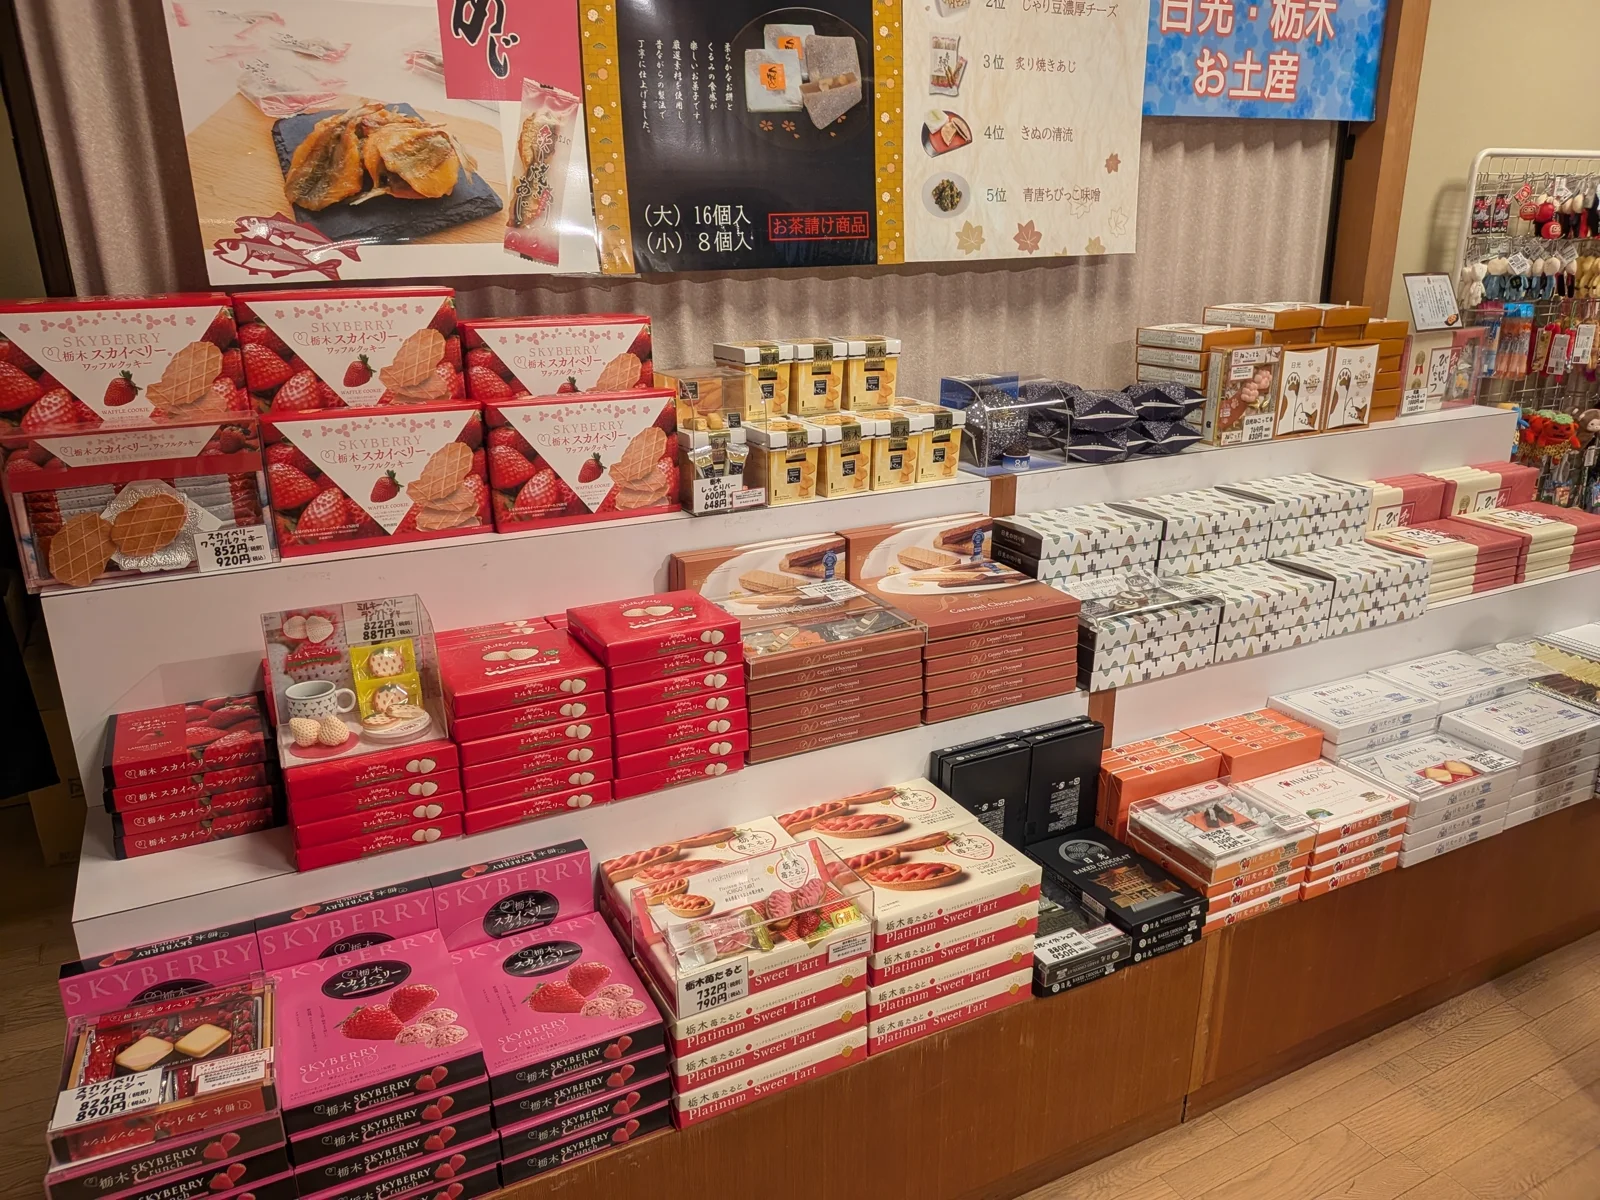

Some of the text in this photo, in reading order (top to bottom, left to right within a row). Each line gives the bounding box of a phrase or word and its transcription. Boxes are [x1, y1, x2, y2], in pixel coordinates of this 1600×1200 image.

[1022, 0, 1118, 18] じゃり豆濃厚チーズ
[1160, 0, 1337, 43] 日光・栃木
[983, 54, 1077, 74] 3位 炙り焼きあじ
[1194, 48, 1299, 100] お土産
[983, 125, 1074, 143] 4位 きぬの清流
[986, 188, 1007, 203] 5位
[645, 204, 751, 227] (大) 16個入
[773, 216, 866, 235] お茶請け商品
[647, 231, 752, 254] (小) 8個入
[310, 320, 395, 333] SKYBERRY
[62, 332, 162, 348] SKYBERRY
[335, 331, 399, 346] スカイベリー
[92, 345, 167, 360] スカイベリー
[326, 344, 386, 355] ワッフルクッキー
[528, 345, 600, 357] SKYBERRY
[82, 360, 153, 372] ワッフルクッキー
[541, 366, 592, 377] ワッフルクッキー
[553, 420, 625, 434] SKYBERRY
[338, 435, 422, 450] SKYBERRY
[565, 443, 616, 454] ワッフルクッキー
[362, 447, 426, 462] スカイベリー
[354, 460, 413, 472] ワッフルクッキー
[701, 484, 736, 493] しっとりバー
[705, 490, 726, 500] 600円
[704, 499, 726, 510] 648円
[200, 535, 263, 548] ワッフルクッキー
[208, 529, 254, 540] スカイベリー
[214, 543, 248, 557] 852円
[216, 554, 250, 567] 920円
[949, 603, 986, 615] Caramel
[363, 619, 395, 630] 822円
[363, 628, 396, 640] 887円
[1291, 773, 1318, 786] NIKKO
[781, 866, 807, 880] 苺たると
[782, 859, 800, 870] 栃木
[1073, 853, 1131, 875] BAKED CHOCOLAT
[438, 857, 588, 912] SKYBERRY
[262, 897, 430, 955] SKYBERRY
[494, 906, 551, 927] スカイベリー
[508, 917, 538, 929] クランチ
[885, 901, 998, 944] Platinum Sweet Tart
[451, 915, 599, 965] SKYBERRY
[270, 932, 437, 982] SKYBERRY
[514, 948, 573, 969] スカイベリー
[66, 941, 256, 1005] SKYBERRY
[335, 970, 401, 990] スカイベリー
[685, 964, 743, 992] 栃木苺たると
[755, 958, 819, 986] Sweet Tart
[696, 982, 727, 1000] 732円
[878, 970, 990, 1013] Platinum Sweet Tart
[696, 993, 728, 1010] 790円
[687, 994, 817, 1048] Platinum Sweet Tart
[498, 1018, 567, 1046] SKYBERRY
[502, 1031, 554, 1054] Crunch
[299, 1045, 379, 1074] SKYBERRY
[526, 1048, 601, 1083] 栃木 SKYBERRY
[552, 1059, 589, 1079] Crunch
[302, 1059, 361, 1085] Crunch
[75, 1081, 146, 1100] ラングドシャ
[77, 1073, 149, 1095] スカイベリー
[689, 1066, 817, 1121] Platinum Sweet Tart
[79, 1092, 126, 1111] 824円
[326, 1079, 411, 1117] 栃木 SKYBERRY
[355, 1090, 398, 1111] Crunch
[75, 1100, 126, 1122] 890円
[334, 1109, 418, 1148] 栃木 SKYBERRY
[362, 1120, 405, 1141] Crunch
[99, 1146, 198, 1190] 栃木 SKYBERRY
[133, 1160, 183, 1184] Crunch
